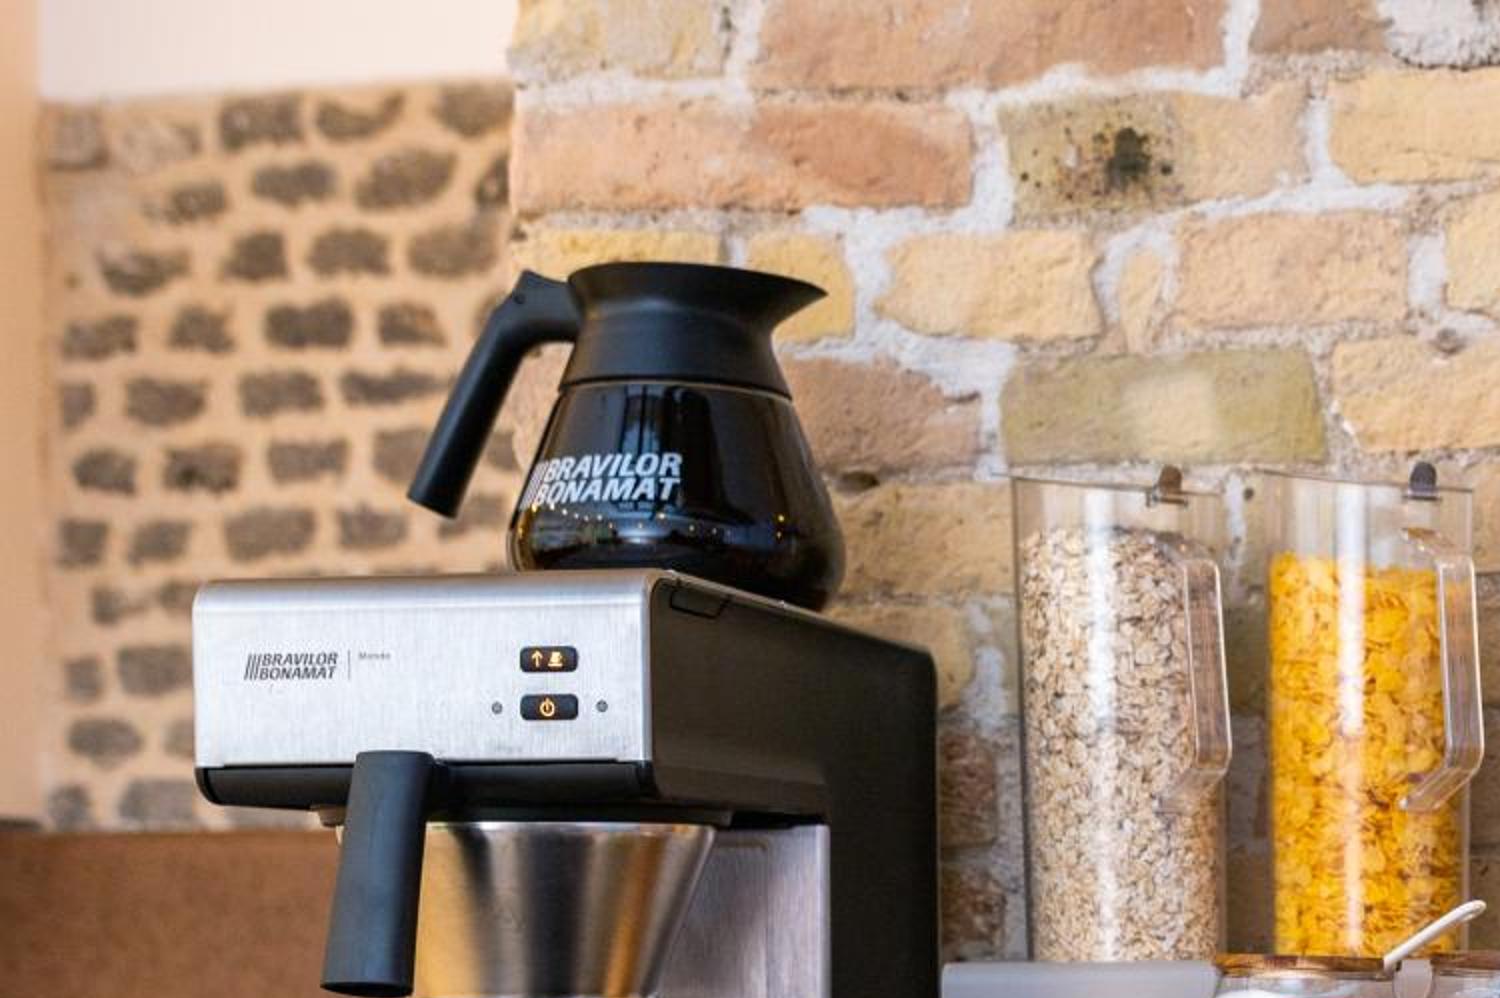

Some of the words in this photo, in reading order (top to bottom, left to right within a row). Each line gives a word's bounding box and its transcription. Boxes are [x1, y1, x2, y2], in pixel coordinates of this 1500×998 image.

[543, 452, 683, 483] BRAVILOR
[533, 477, 681, 506] BONAMAT
[261, 651, 339, 667] BRAVILOR
[258, 665, 337, 681] BONAMAT
